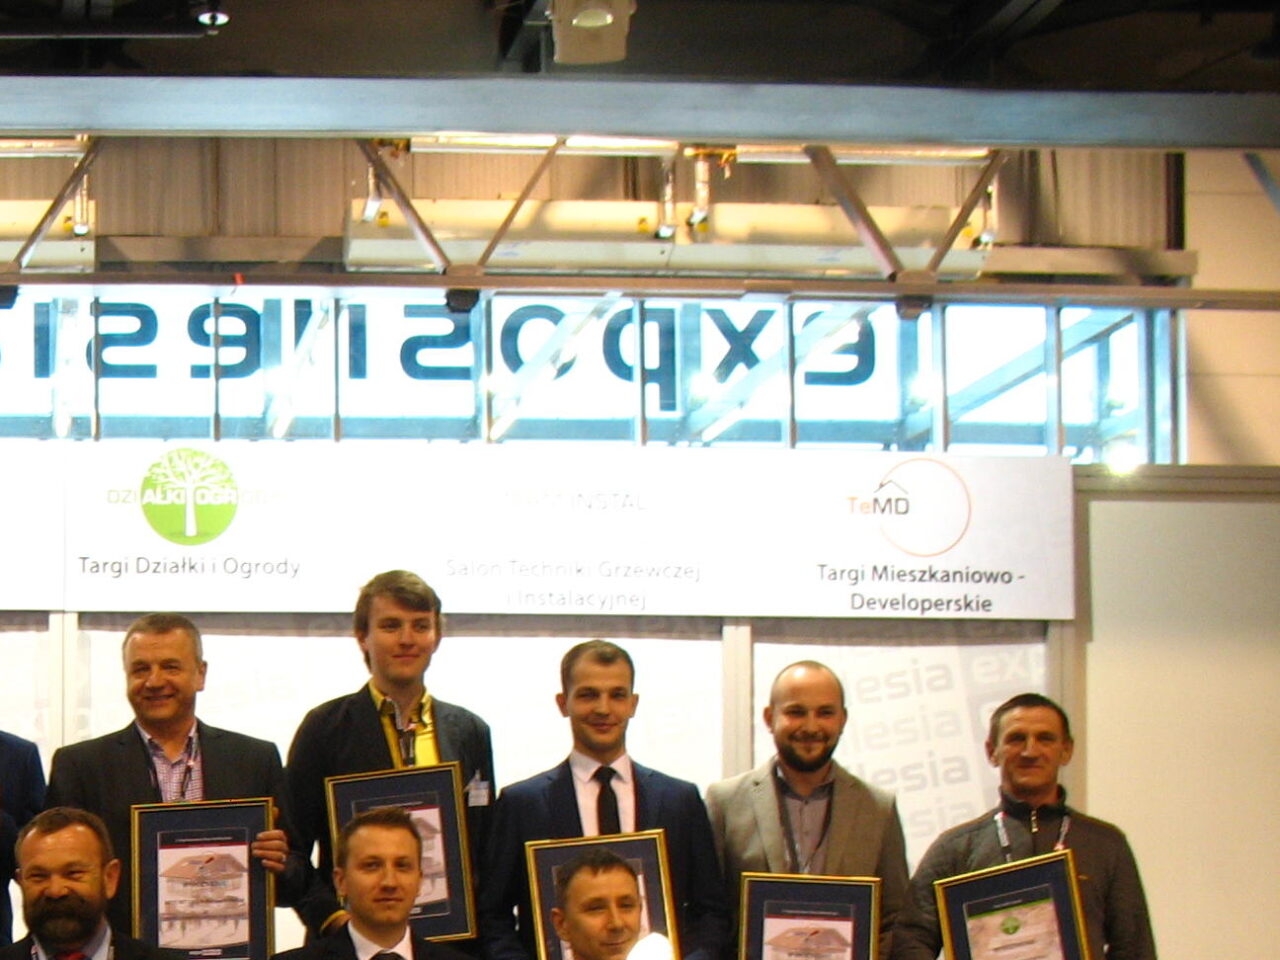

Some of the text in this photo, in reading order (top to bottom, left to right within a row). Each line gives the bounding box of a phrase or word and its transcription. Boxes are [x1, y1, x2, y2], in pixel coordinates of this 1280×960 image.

[848, 497, 910, 516] TeMD
[78, 556, 301, 579] Targi Działki i Ogrody
[446, 559, 502, 577] Salon
[598, 560, 701, 582] Grzewczej
[818, 564, 866, 586] Targi
[872, 565, 1013, 585] Mieszkaniowo
[851, 592, 993, 616] Developerskie
